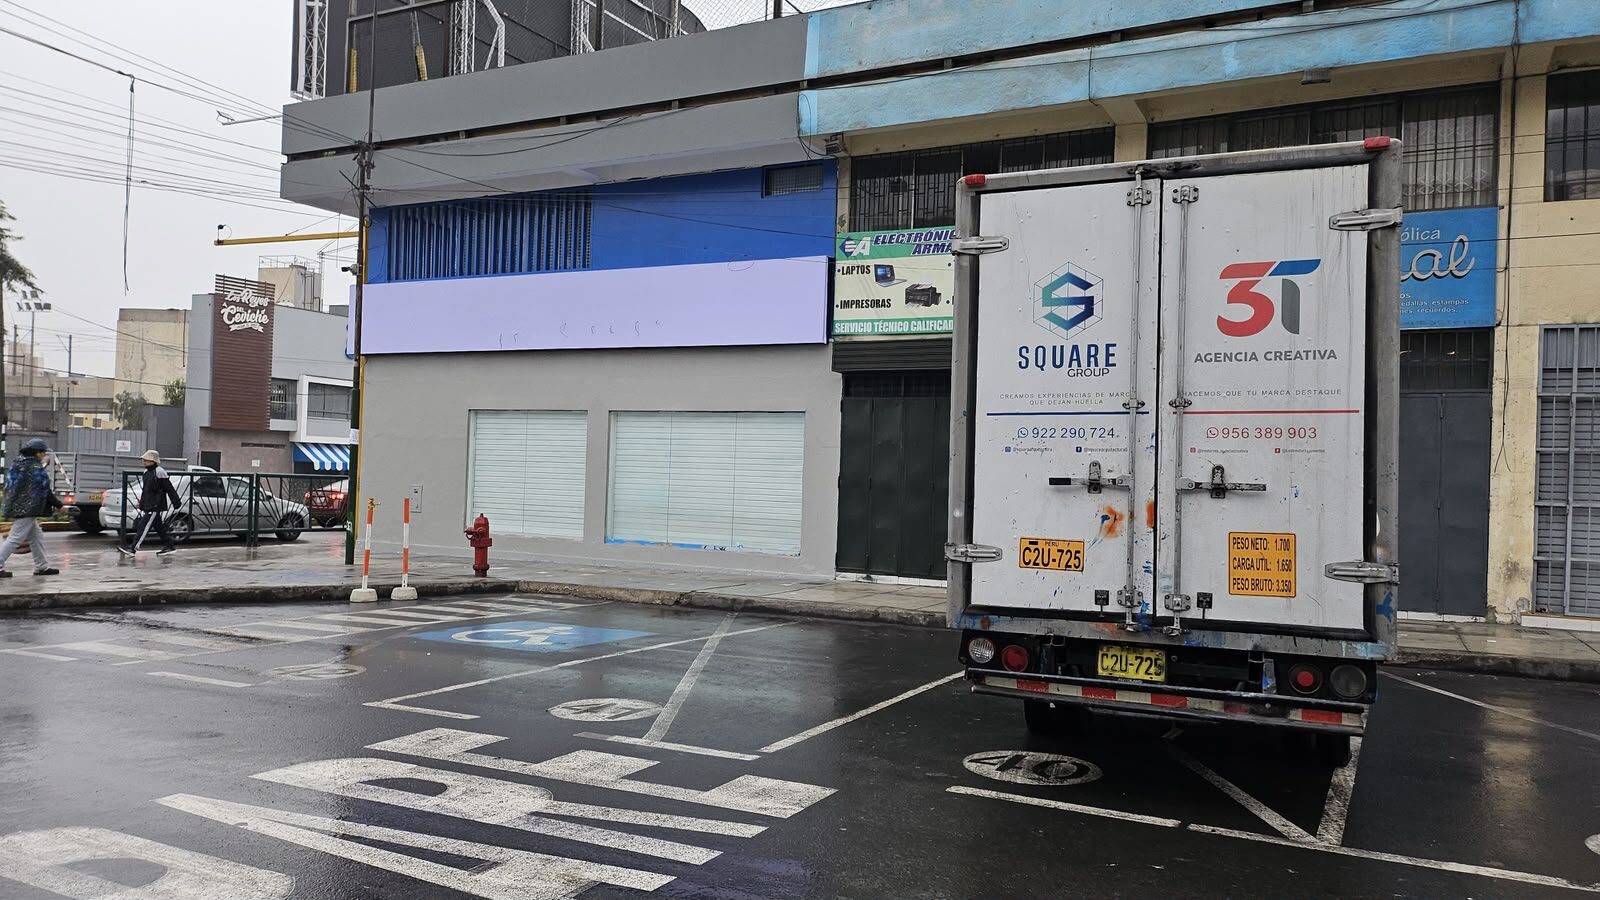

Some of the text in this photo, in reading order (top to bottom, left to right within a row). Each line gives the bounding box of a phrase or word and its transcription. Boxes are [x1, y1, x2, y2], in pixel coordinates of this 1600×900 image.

[841, 265, 871, 275] LAPTOS
[241, 288, 270, 307] Reyes
[840, 298, 892, 310] IMPRESORAS
[1216, 258, 1321, 337] 3T
[221, 305, 269, 325] Ceviche
[834, 321, 872, 333] SERVICIO
[873, 319, 910, 332] TÉCNICO
[1018, 343, 1117, 371] SQUARE
[1194, 349, 1338, 363] AGENCIA CREATIVA
[1067, 367, 1110, 378] GROUP
[1031, 427, 1115, 439] 922 290 724
[1221, 427, 1317, 439] 956 389 903
[1232, 537, 1291, 551] PESO NETO: 1.700
[1022, 546, 1081, 569] C2U-725
[1232, 557, 1255, 571] CARGA
[1276, 559, 1292, 572] 1.650
[1232, 577, 1292, 592] PESO BRUTO: 3.350
[1100, 652, 1163, 677] C2U-725
[967, 754, 1091, 780] 40
